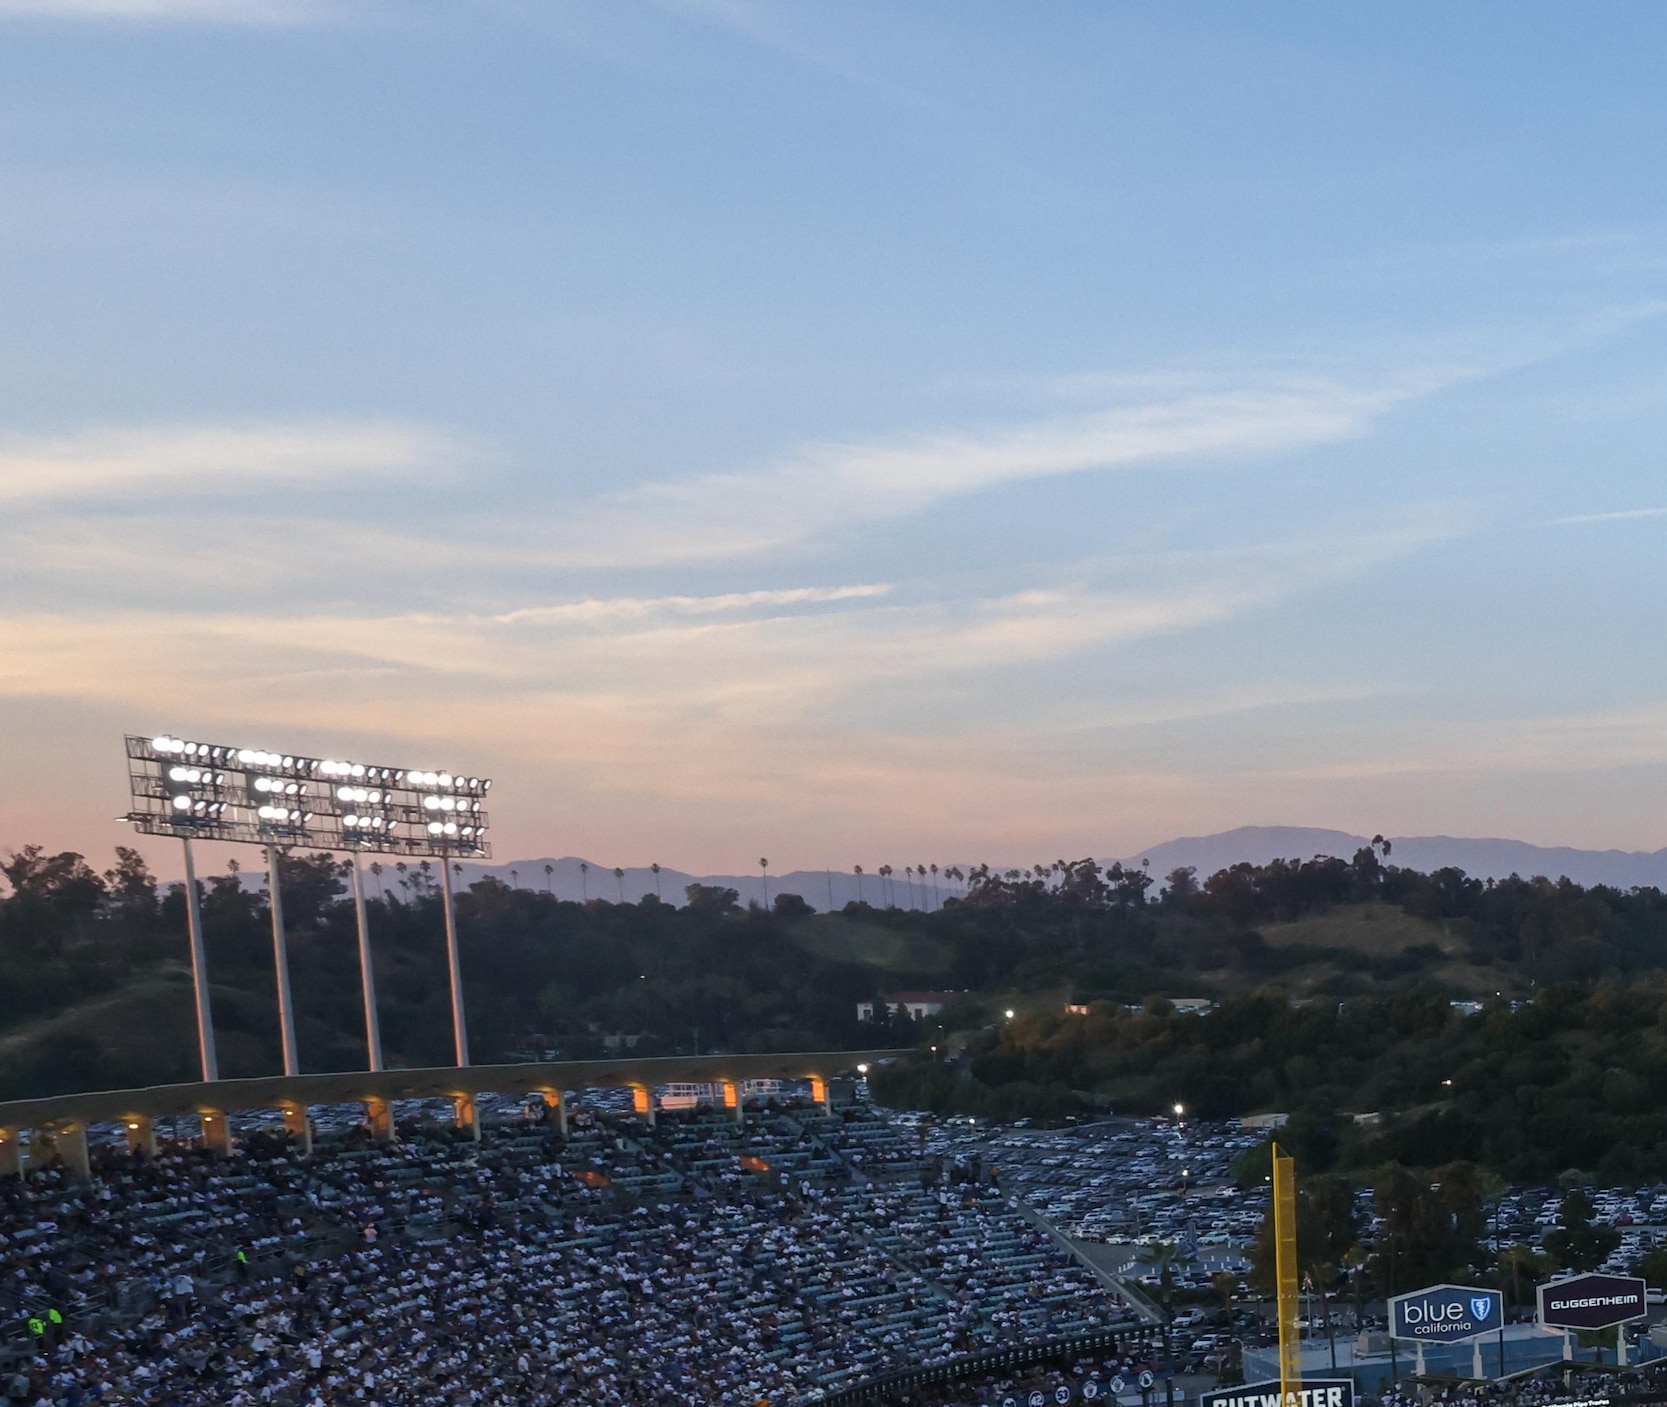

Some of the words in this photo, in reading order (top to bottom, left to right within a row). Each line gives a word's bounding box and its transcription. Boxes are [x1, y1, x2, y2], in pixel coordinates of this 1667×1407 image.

[1550, 1294, 1639, 1310] GUGGENHEIM
[1404, 1300, 1464, 1323] blue
[1414, 1321, 1472, 1336] california
[1031, 1395, 1043, 1407] 42
[1056, 1389, 1068, 1400] 53
